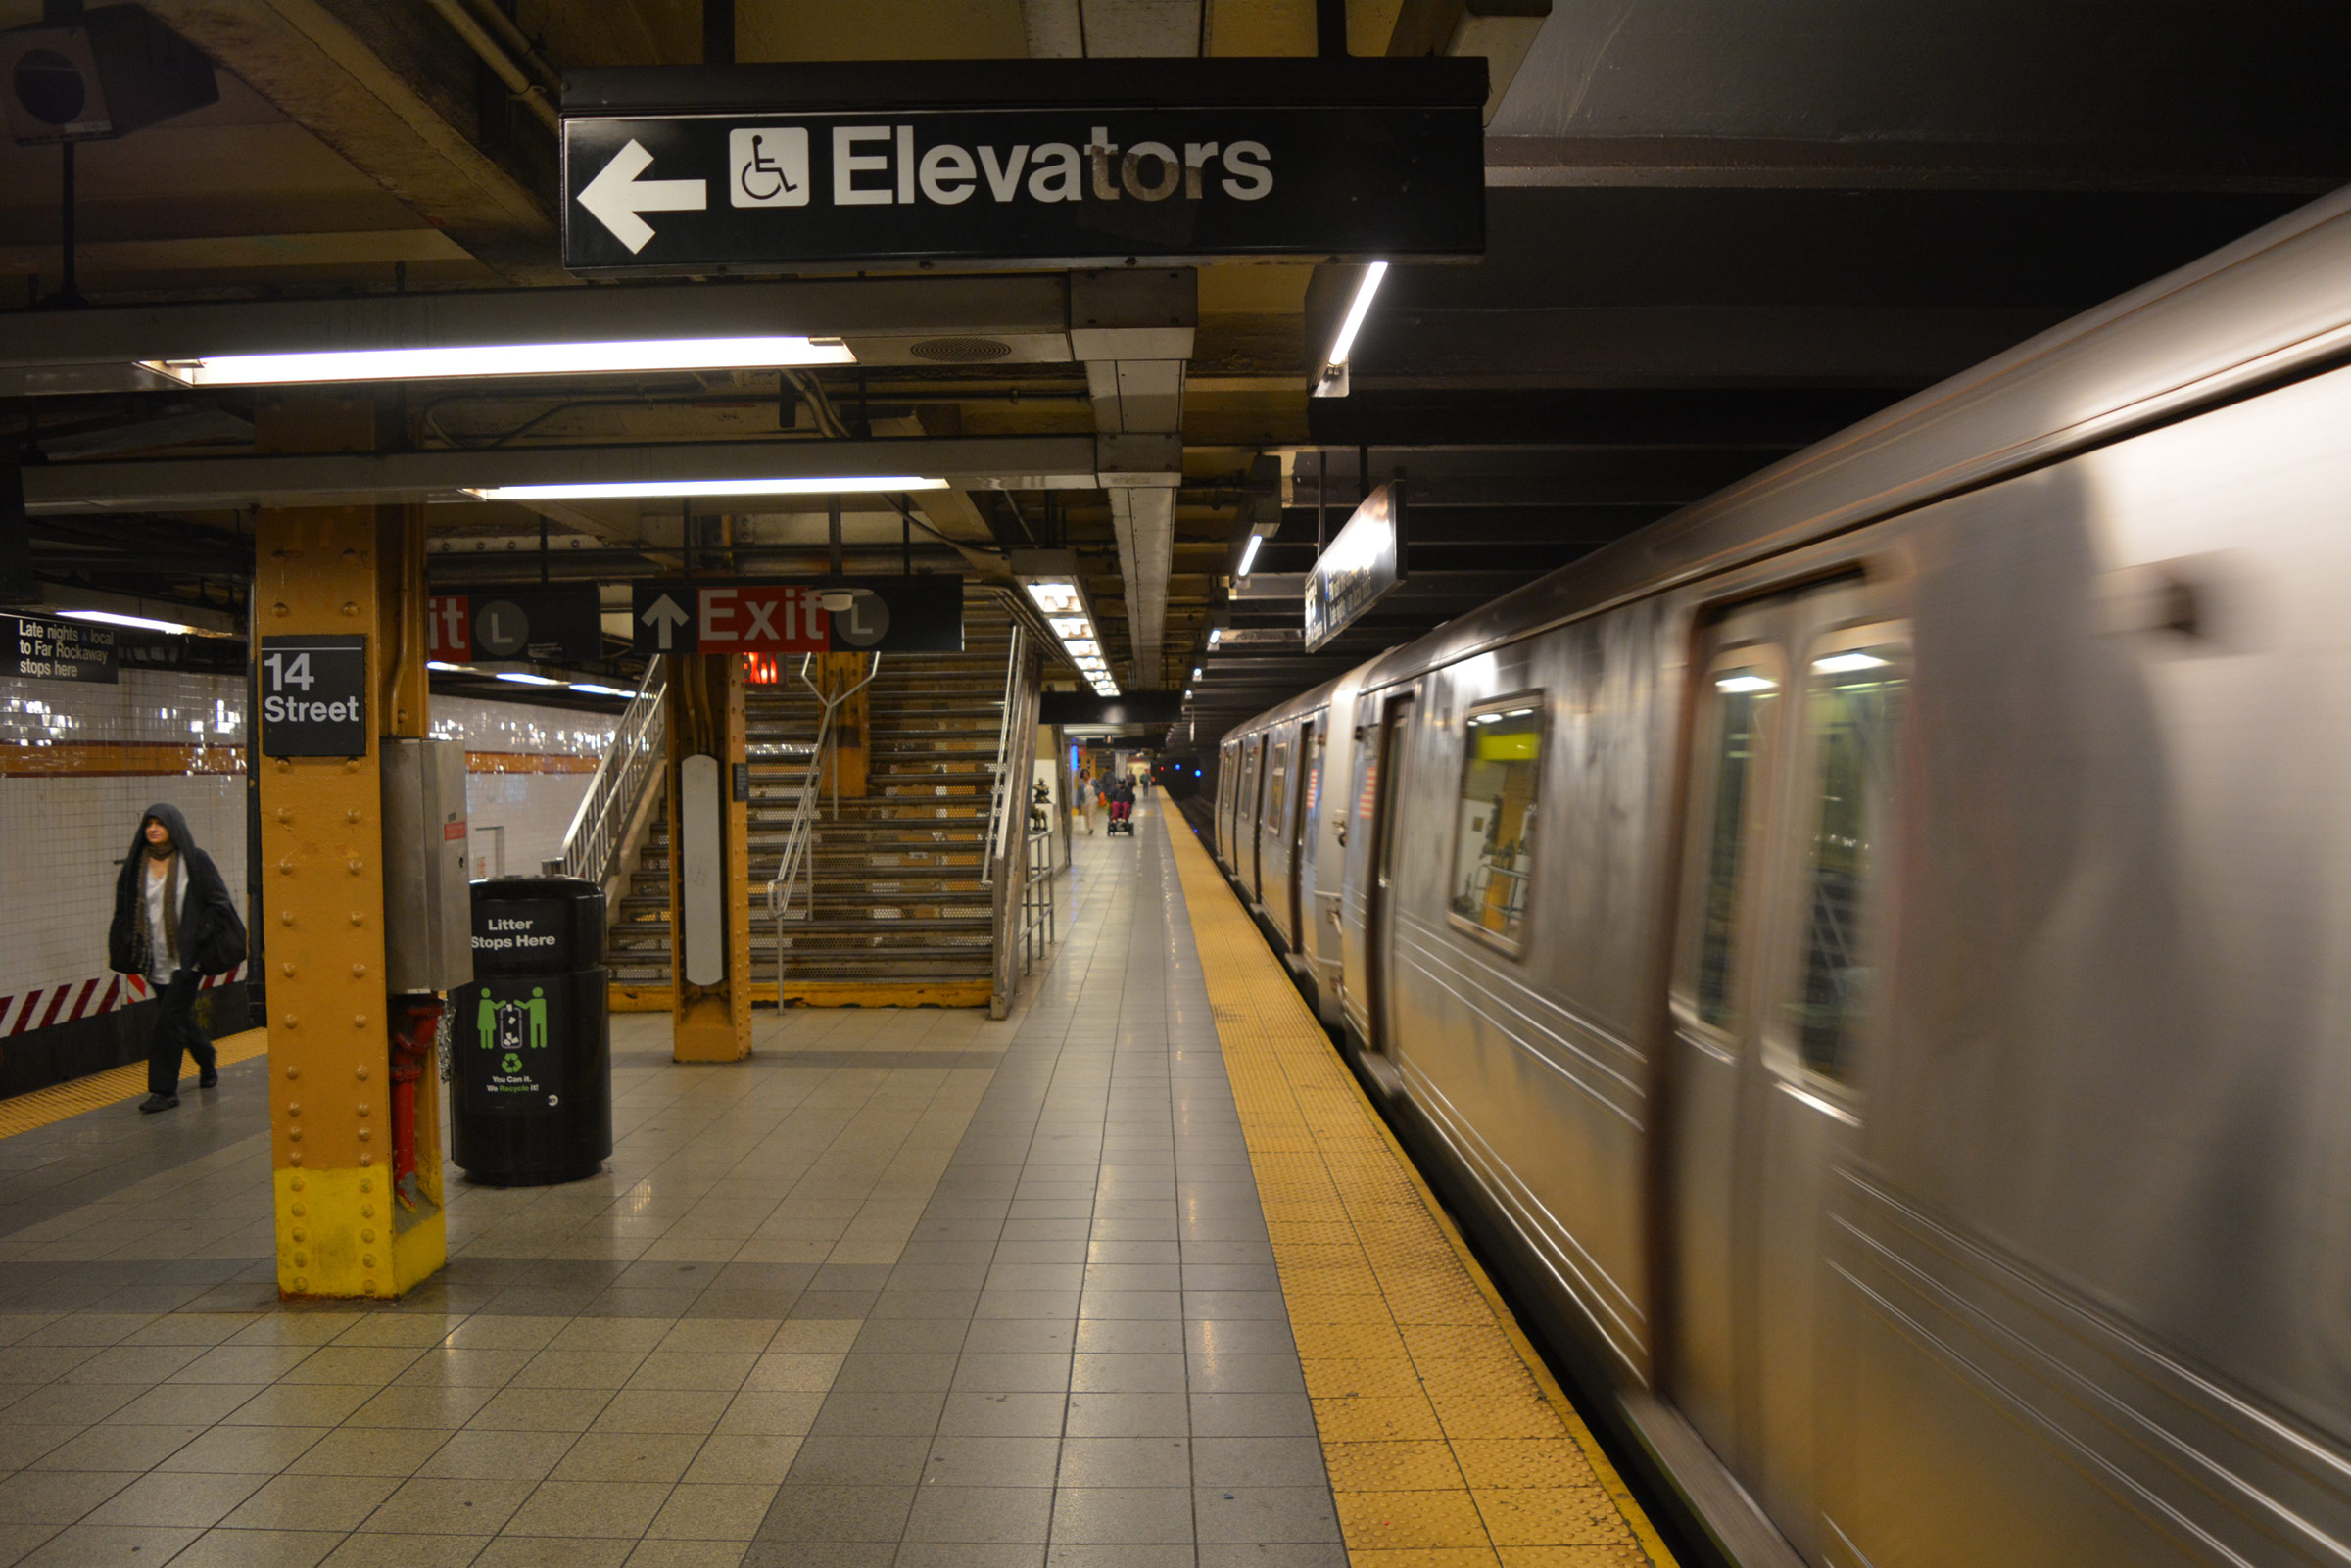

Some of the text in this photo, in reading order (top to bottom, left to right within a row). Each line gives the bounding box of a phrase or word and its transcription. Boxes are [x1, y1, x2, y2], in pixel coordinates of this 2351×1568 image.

[832, 125, 1273, 206] Elevators
[699, 588, 824, 641] Exit
[19, 619, 44, 638] Late
[47, 621, 79, 643] nights
[90, 628, 115, 646] local
[19, 640, 108, 665] to Far Rockaway
[20, 658, 78, 678] stops here
[264, 652, 314, 691] 14
[264, 696, 360, 723] Street
[488, 919, 534, 930] Litter
[471, 934, 555, 950] Stops Here
